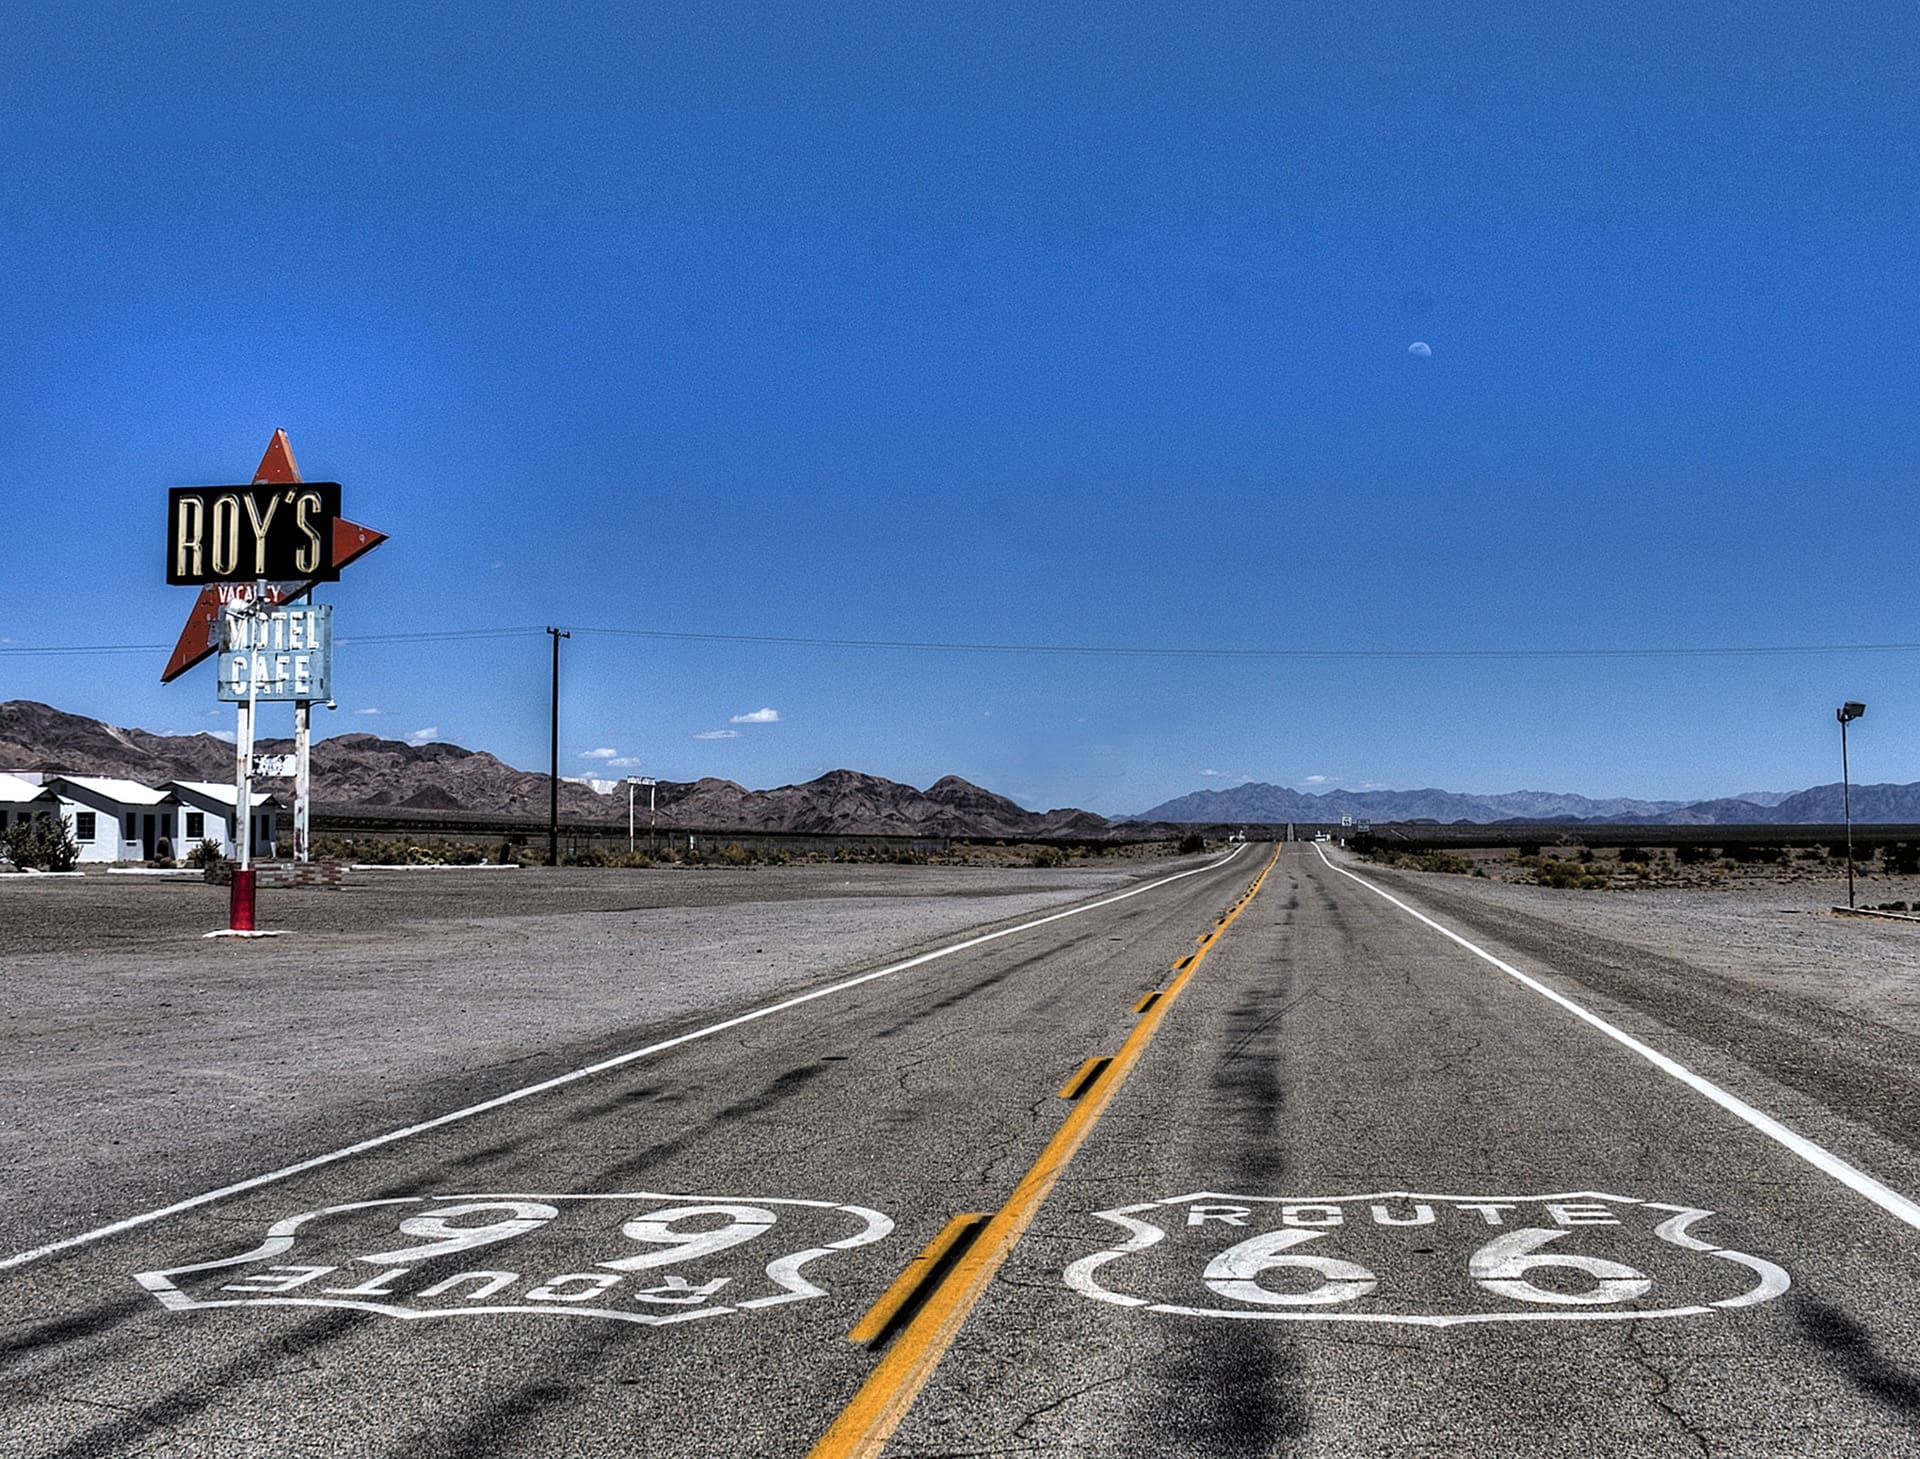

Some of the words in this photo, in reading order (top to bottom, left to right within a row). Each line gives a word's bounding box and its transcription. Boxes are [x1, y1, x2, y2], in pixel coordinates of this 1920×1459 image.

[177, 488, 321, 576] ROY'S
[218, 585, 280, 603] VACAY
[229, 611, 320, 650] MOTEL
[231, 655, 310, 695] CAFE
[1187, 1203, 1622, 1228] ROUTE
[357, 1202, 778, 1271] 66
[221, 1266, 732, 1304] ROUTE
[1202, 1228, 1652, 1304] 66
